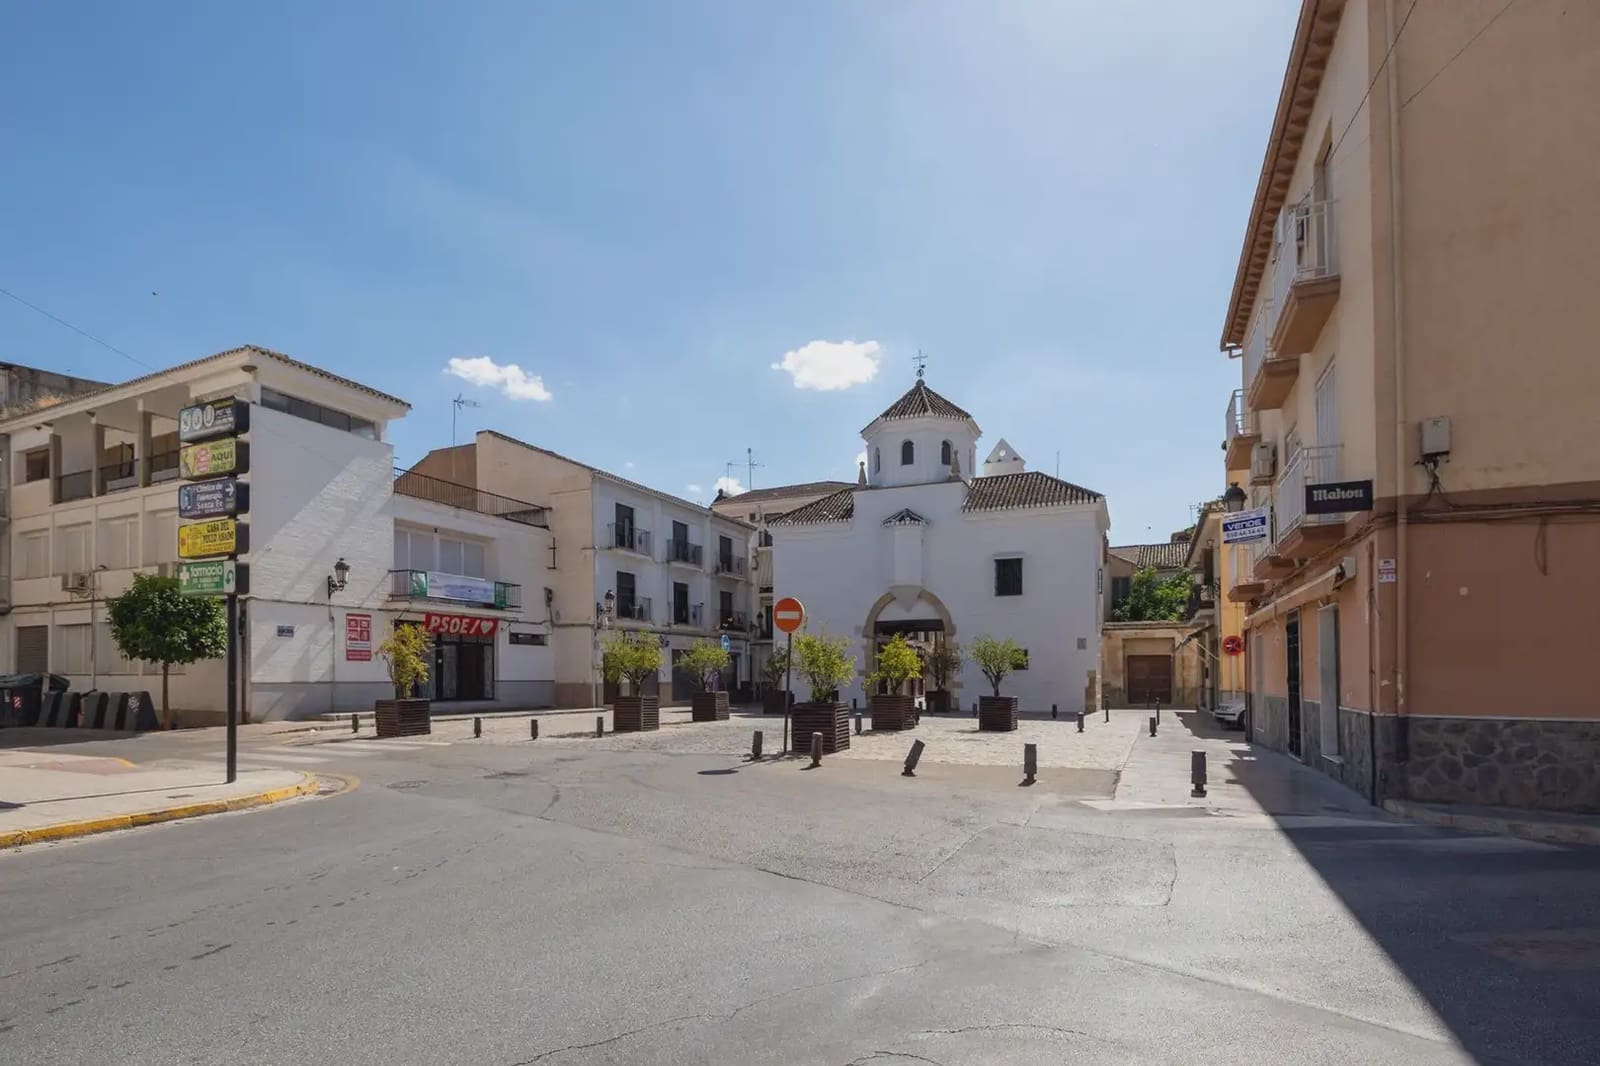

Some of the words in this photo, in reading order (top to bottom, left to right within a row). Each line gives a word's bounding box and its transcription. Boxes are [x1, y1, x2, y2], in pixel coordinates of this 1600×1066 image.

[1312, 487, 1364, 501] Mahou
[1227, 518, 1263, 530] VENDE
[191, 562, 223, 577] farmacia
